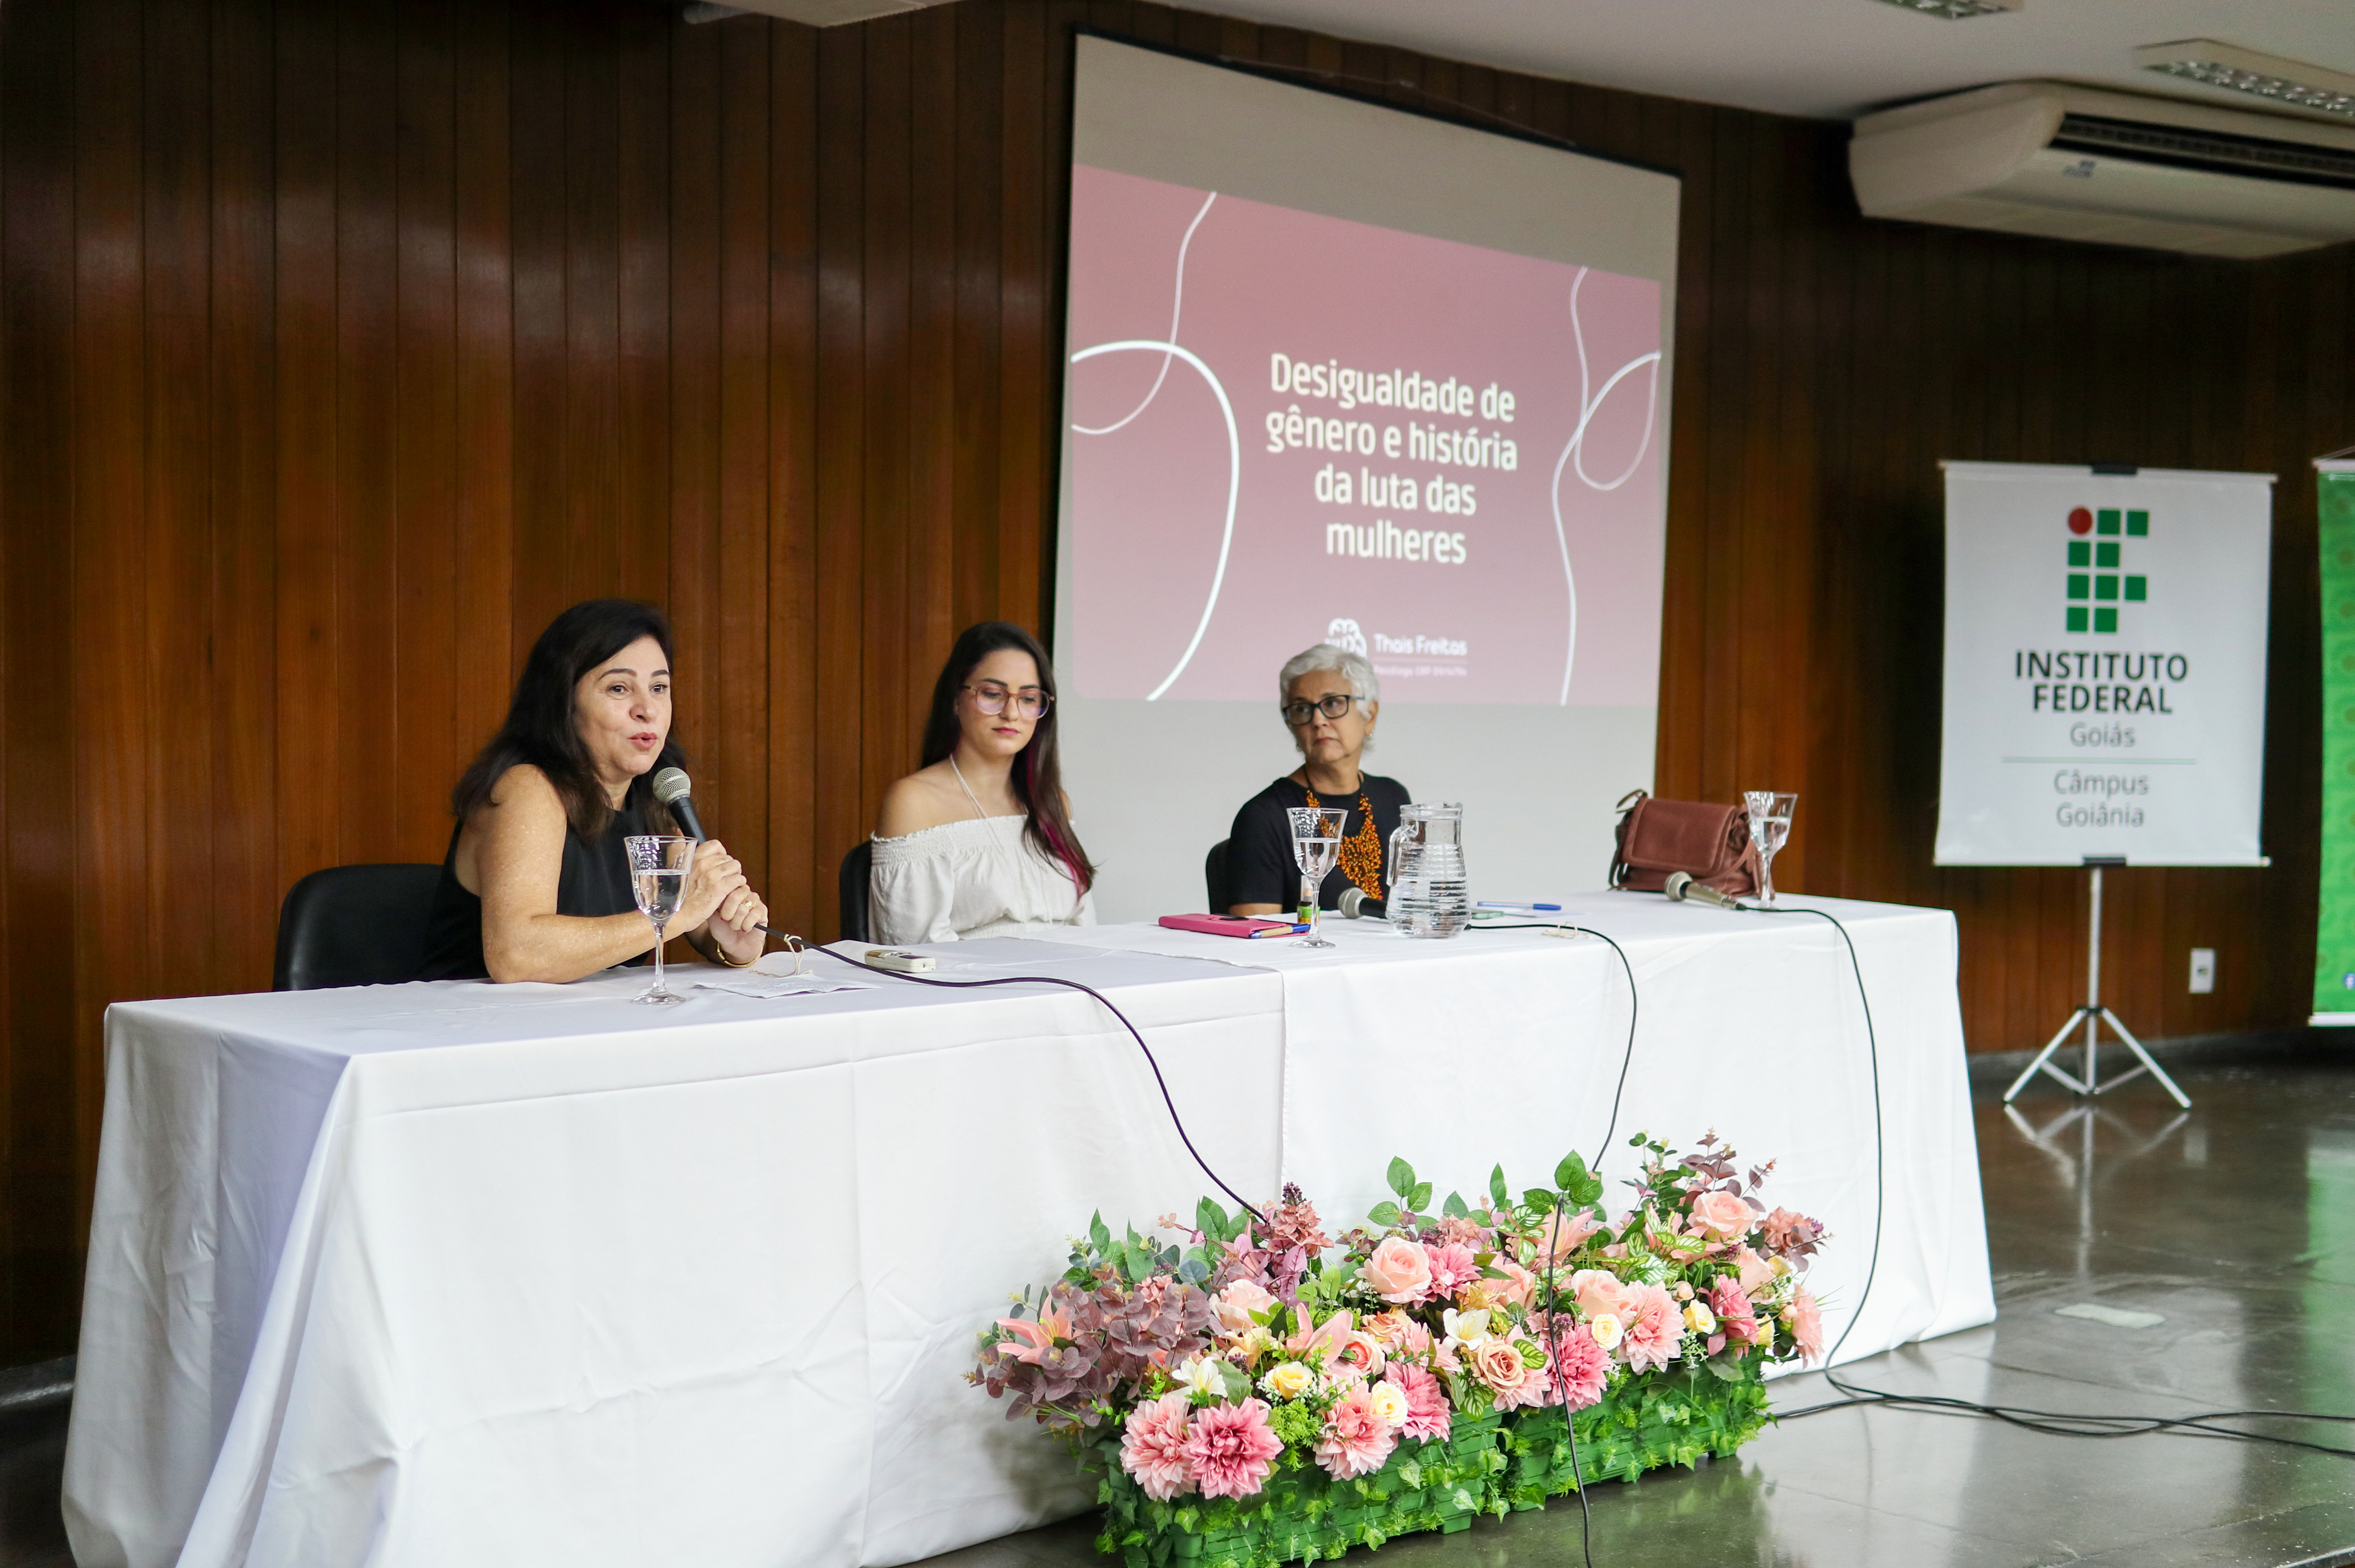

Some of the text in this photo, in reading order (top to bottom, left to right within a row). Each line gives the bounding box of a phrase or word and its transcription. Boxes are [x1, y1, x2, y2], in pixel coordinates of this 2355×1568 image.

[1270, 352, 1516, 423] Desigualdade de
[1265, 404, 1518, 471] gênero e história
[1314, 463, 1477, 516] da luta das
[1326, 520, 1467, 565] mulheres
[2015, 650, 2189, 682] INSTITUTO
[2033, 683, 2172, 714] FEDERAL
[2070, 722, 2136, 747] Goiás
[2054, 768, 2149, 799] Câmpus
[2056, 801, 2144, 827] Goiânia
